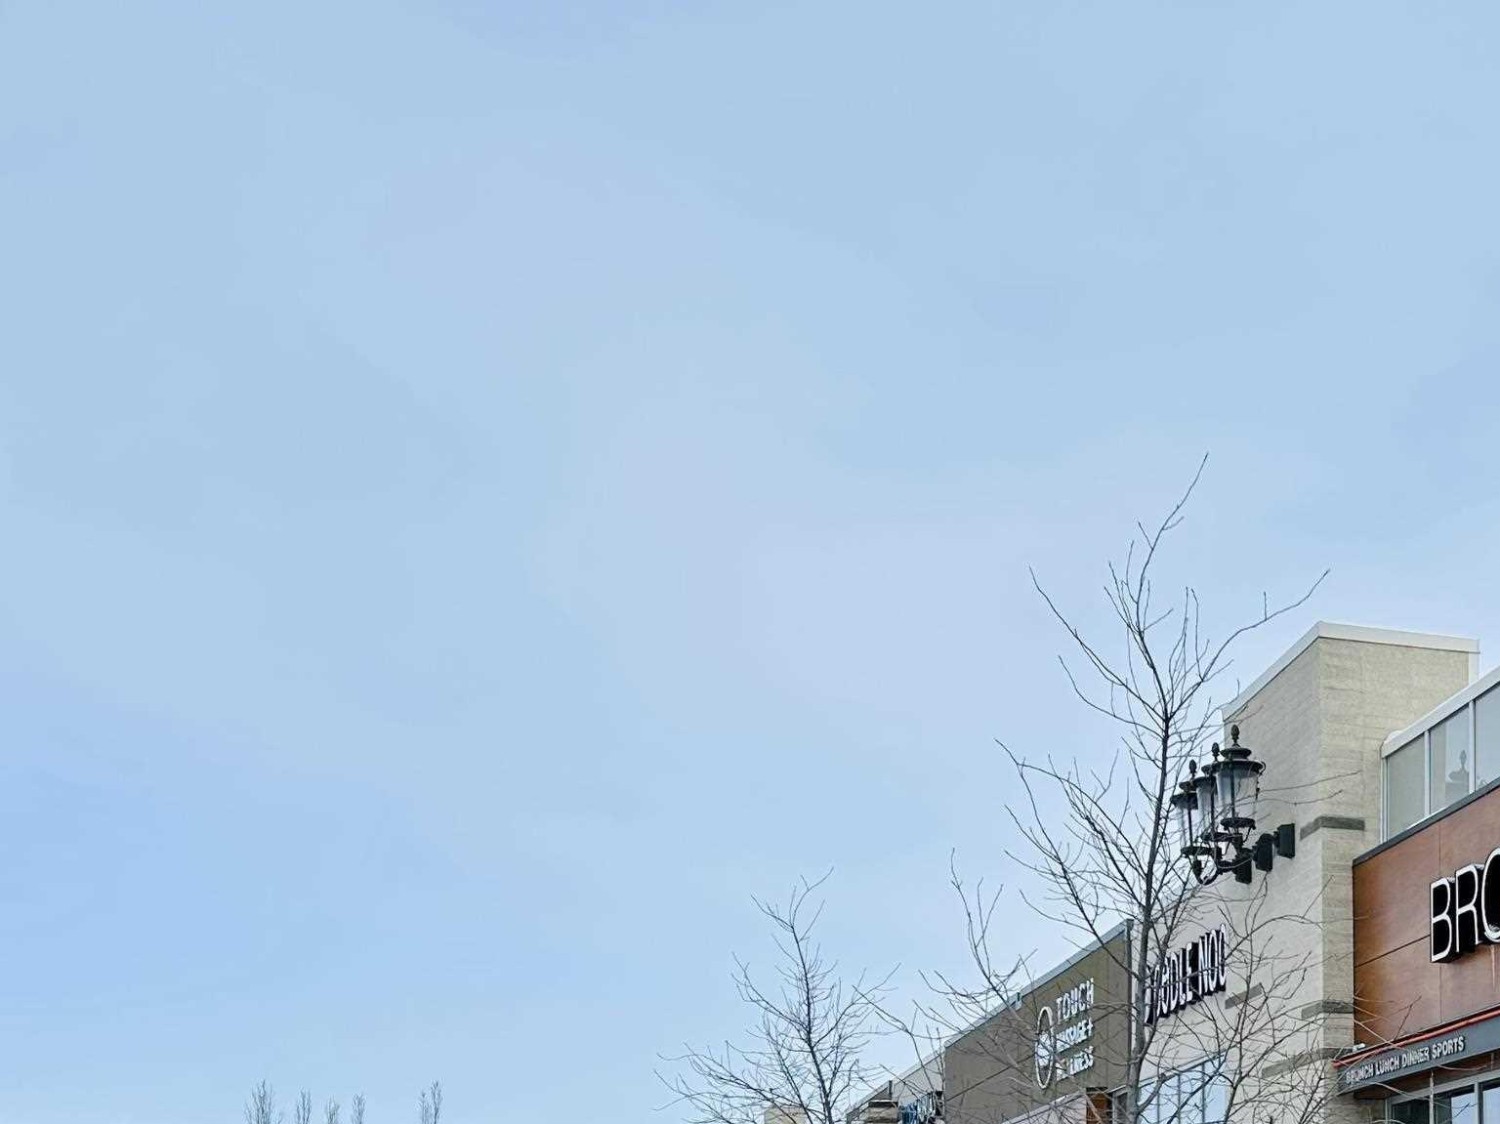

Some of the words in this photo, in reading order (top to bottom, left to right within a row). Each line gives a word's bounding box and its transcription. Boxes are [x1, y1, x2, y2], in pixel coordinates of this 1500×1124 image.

[1056, 977, 1094, 1024] TOUCH
[1375, 1056, 1400, 1075] LUNCH
[1401, 1046, 1430, 1068] DINNER
[1432, 1036, 1465, 1059] SPORTS
